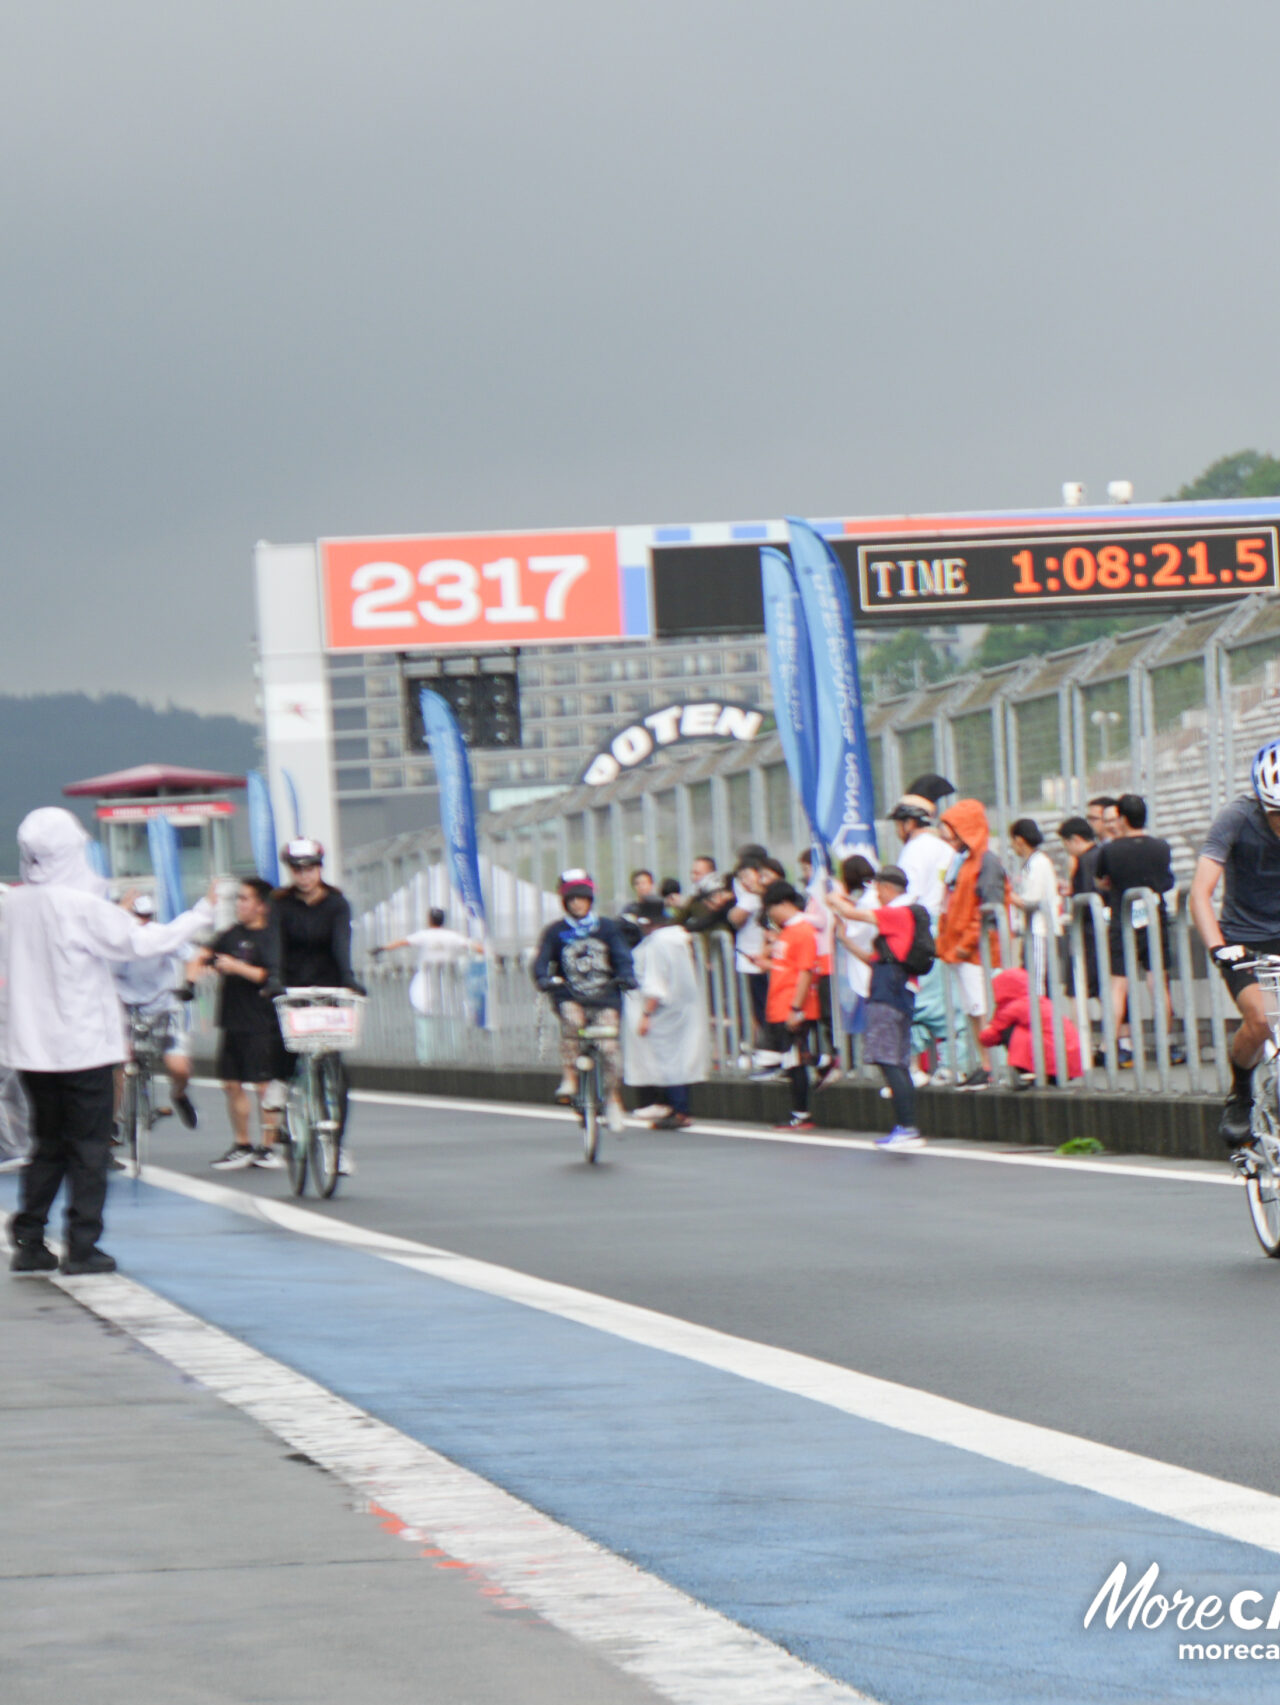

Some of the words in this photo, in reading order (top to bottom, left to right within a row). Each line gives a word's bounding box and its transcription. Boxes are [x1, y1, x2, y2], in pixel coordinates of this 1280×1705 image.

[351, 554, 591, 630] 2317
[870, 558, 969, 598] TIME
[1011, 538, 1268, 594] 1:08:21.5
